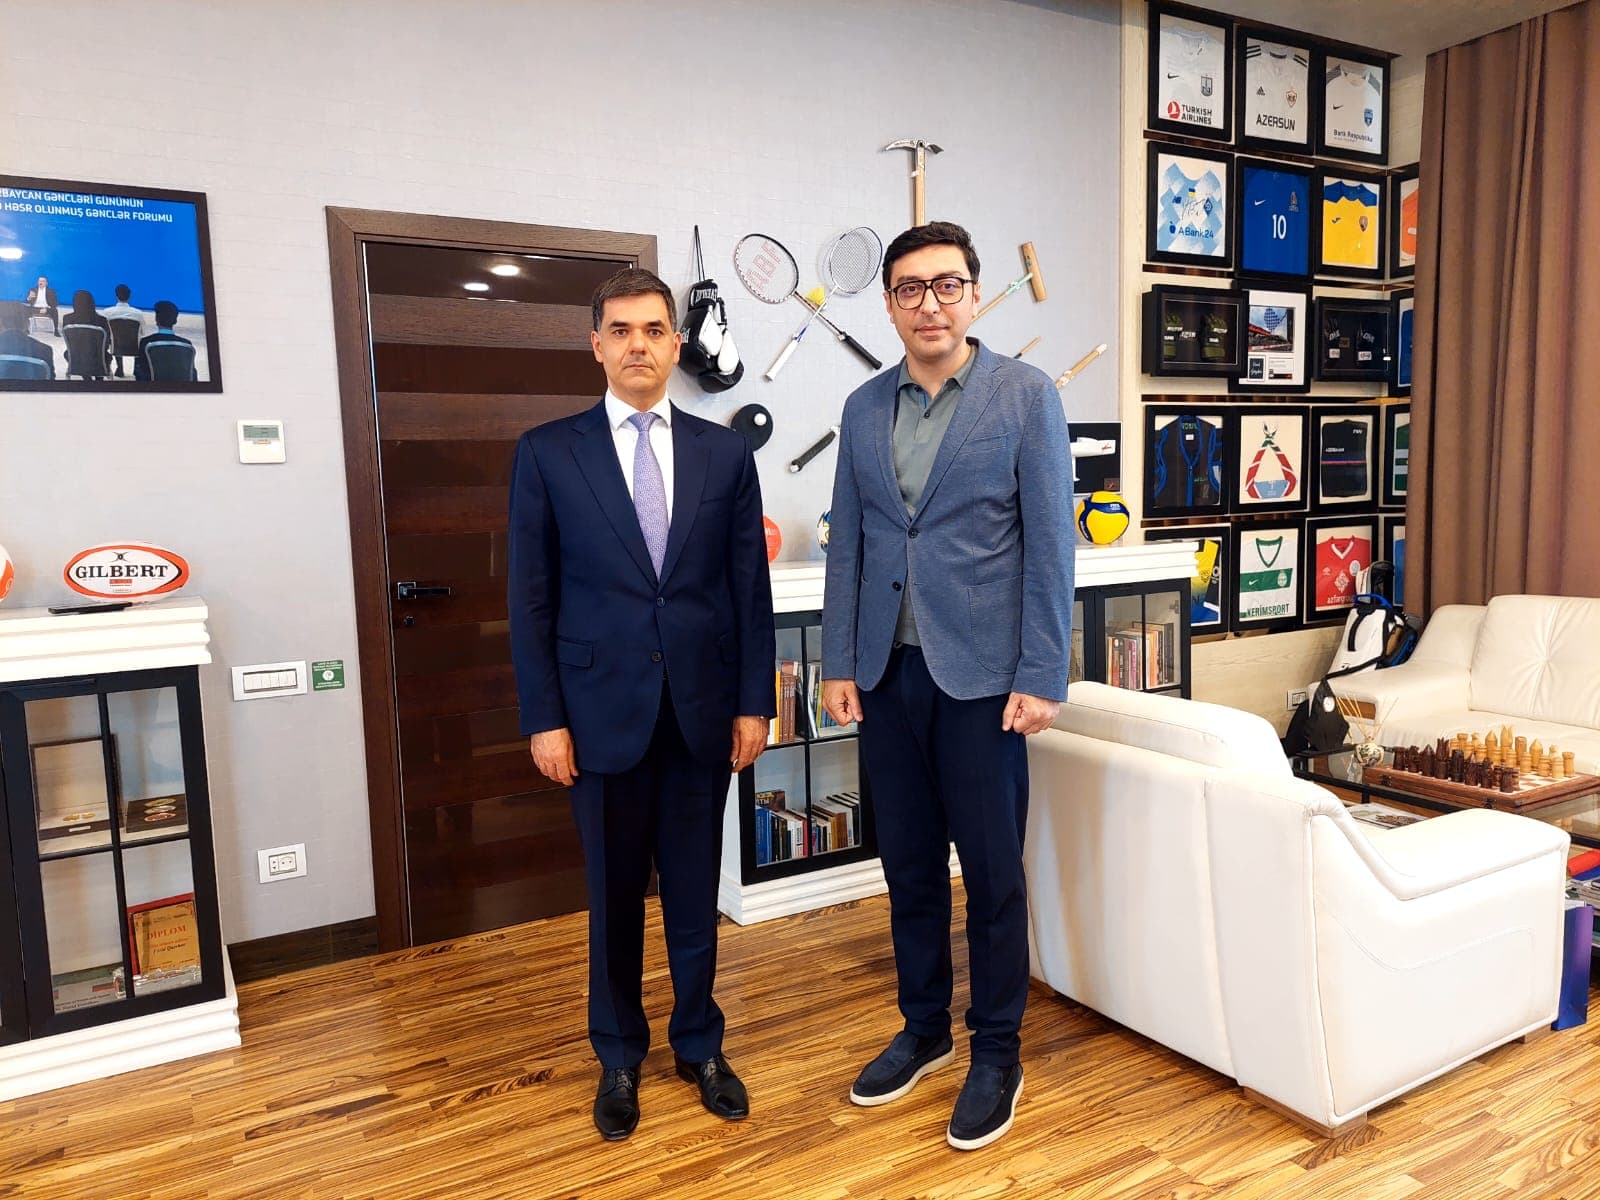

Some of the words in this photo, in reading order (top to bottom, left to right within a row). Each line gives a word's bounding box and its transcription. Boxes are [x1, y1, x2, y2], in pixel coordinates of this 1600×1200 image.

[1181, 104, 1213, 116] TURKISH
[1181, 113, 1212, 125] AIRLINES
[1256, 113, 1296, 131] AZERSUN
[4, 202, 33, 213] HƏSR
[132, 211, 173, 222] FORUMU
[1272, 213, 1287, 240] 10
[75, 565, 168, 579] GILBERT
